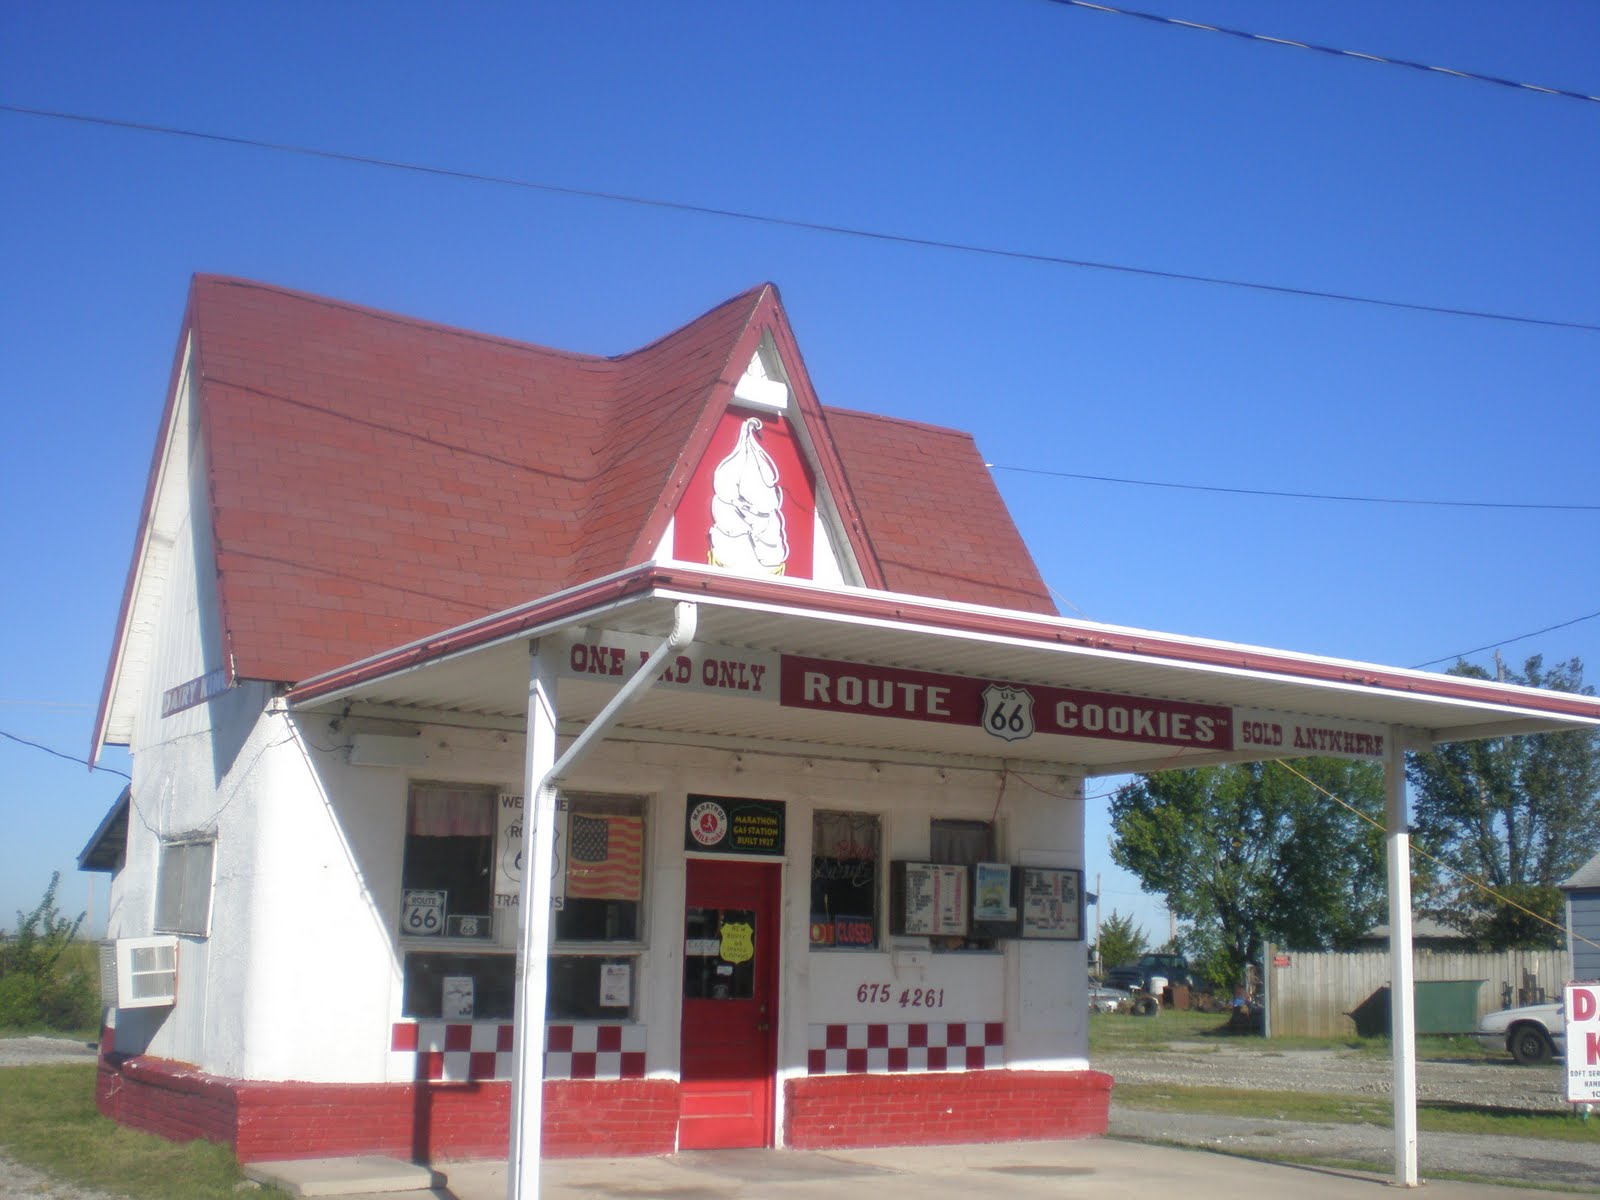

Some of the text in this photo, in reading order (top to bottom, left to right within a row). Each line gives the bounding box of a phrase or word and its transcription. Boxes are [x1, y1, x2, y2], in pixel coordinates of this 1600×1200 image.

[570, 643, 625, 676] ONE
[702, 658, 766, 691] ONLY
[804, 671, 950, 716] ROUTE
[1001, 692, 1016, 701] US
[990, 702, 1025, 733] 66
[1056, 701, 1215, 742] COOKIES
[1242, 720, 1384, 756] SOLD ANYWHERE
[692, 803, 726, 821] MARATHON
[735, 815, 777, 825] MARATHON
[737, 836, 758, 845] BUILT
[748, 826, 778, 836] STATION
[411, 897, 437, 905] ROUTE
[410, 907, 437, 928] 66
[463, 926, 474, 934] 66
[837, 920, 872, 944] CLOSED
[857, 984, 944, 1008] 675 4261
[1573, 989, 1600, 1021] D
